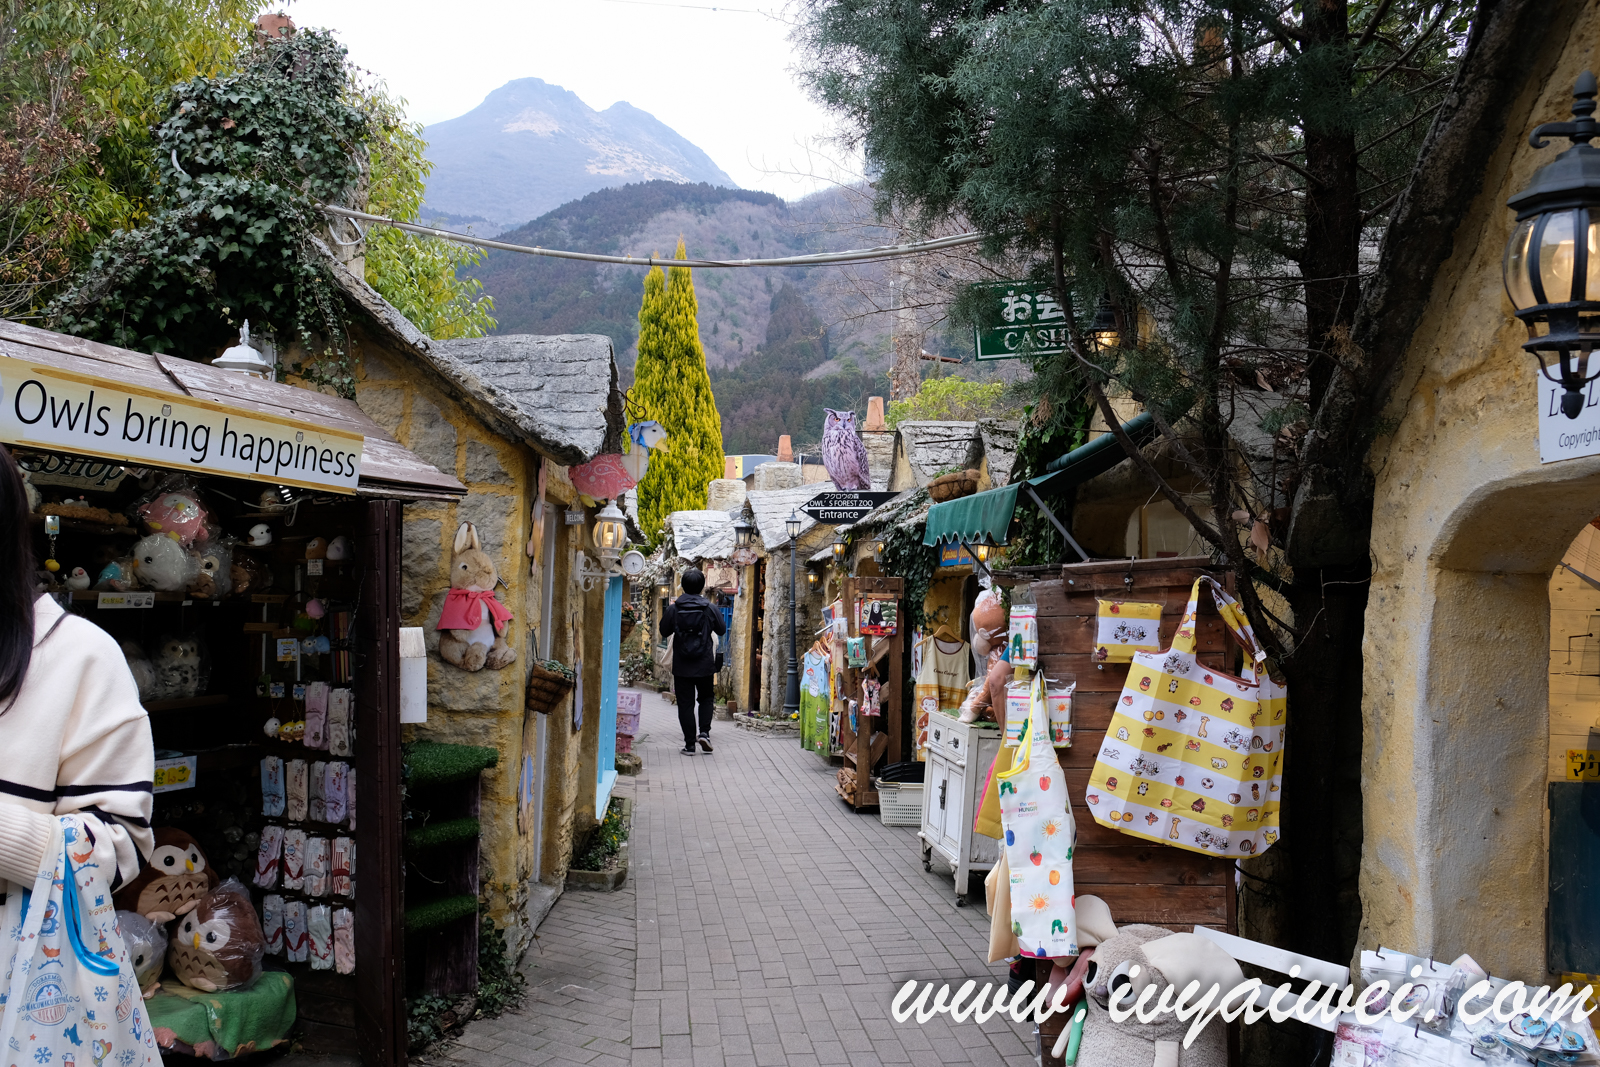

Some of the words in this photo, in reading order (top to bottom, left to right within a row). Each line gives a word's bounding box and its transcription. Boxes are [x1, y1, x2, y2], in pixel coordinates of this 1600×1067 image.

[14, 379, 111, 437] Owls
[122, 397, 211, 464] bring
[220, 417, 356, 478] happiness
[566, 513, 584, 522] WELCOME
[819, 509, 858, 519] Entrance
